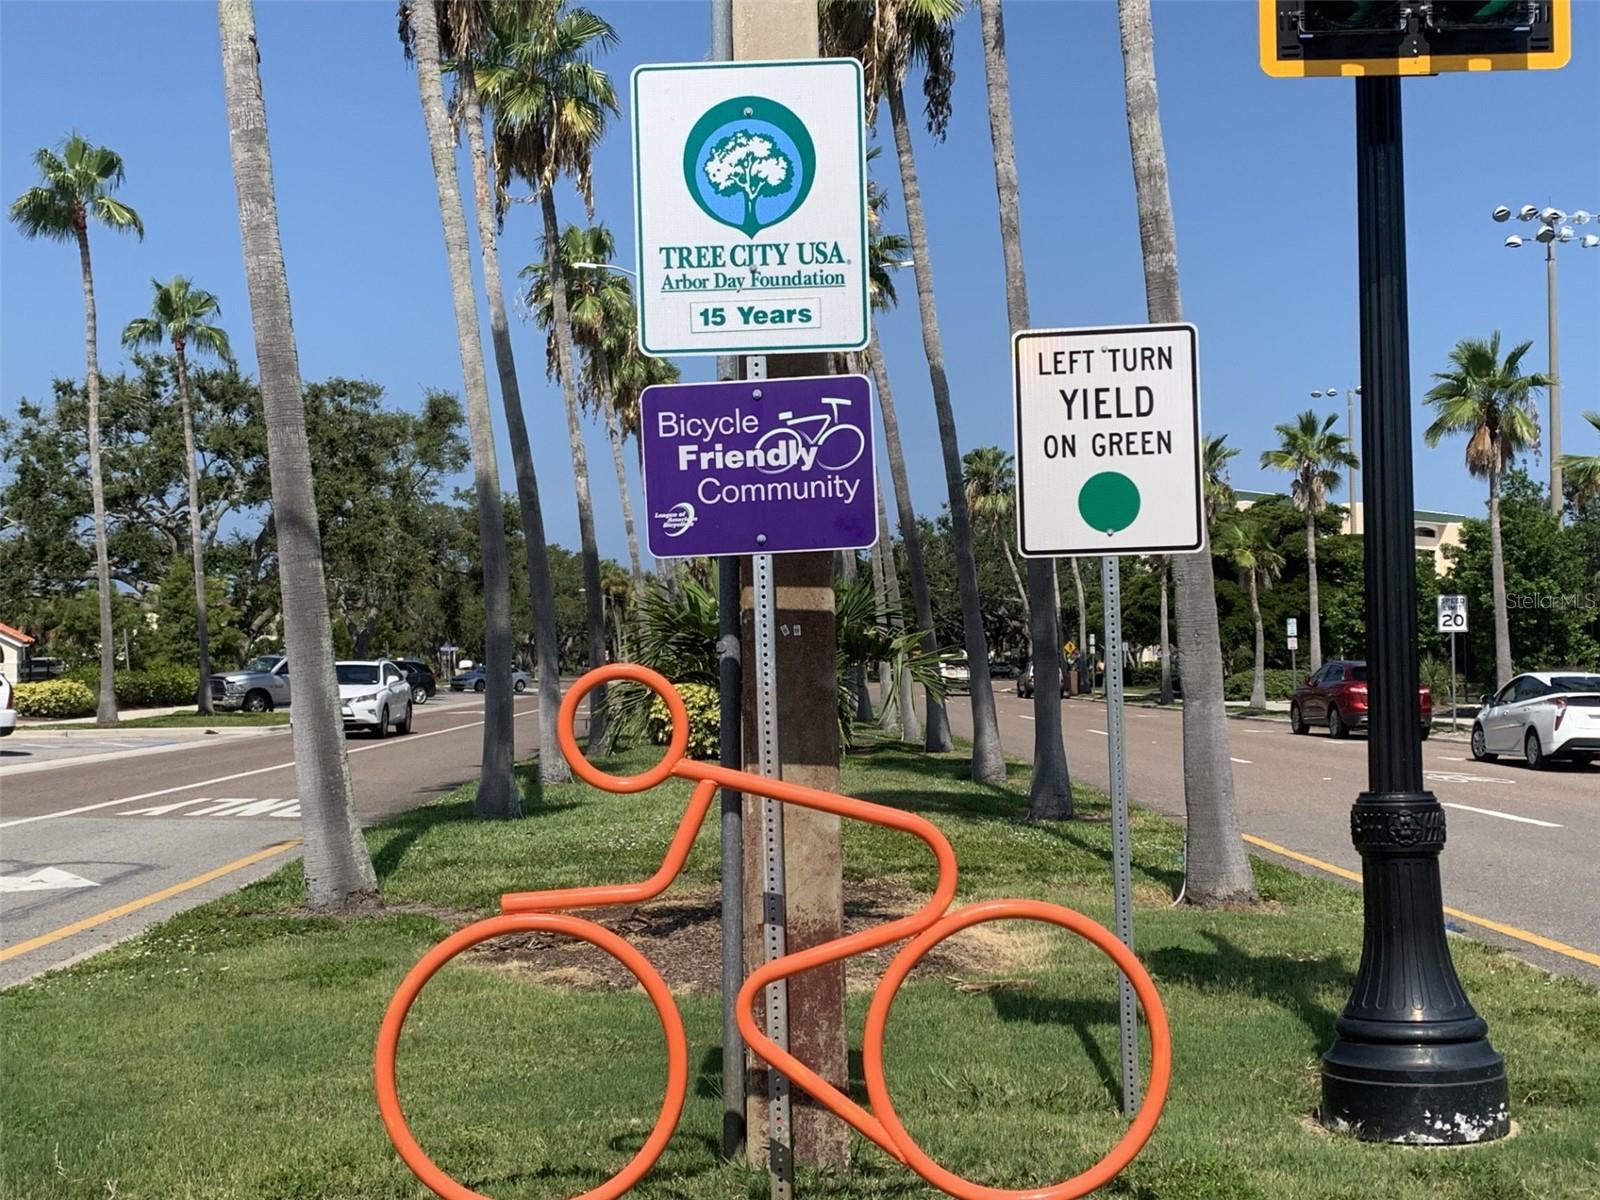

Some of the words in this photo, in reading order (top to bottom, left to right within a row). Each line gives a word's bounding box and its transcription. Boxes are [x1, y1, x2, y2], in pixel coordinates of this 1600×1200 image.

[659, 245, 726, 270] TREE
[729, 243, 790, 268] CITY
[662, 274, 709, 290] Arbor
[713, 272, 745, 293] Day
[751, 269, 846, 287] Foundation
[699, 308, 726, 326] 15
[737, 306, 812, 325] Years
[1038, 350, 1095, 376] LEFT
[1107, 346, 1173, 372] TURN
[1059, 386, 1154, 420] YIELD
[658, 408, 760, 442] Bicycle
[678, 439, 818, 471] Friendly
[1044, 434, 1076, 459] ON
[1092, 430, 1172, 457] GREEN
[697, 474, 861, 504] Community
[1442, 614, 1464, 627] 20
